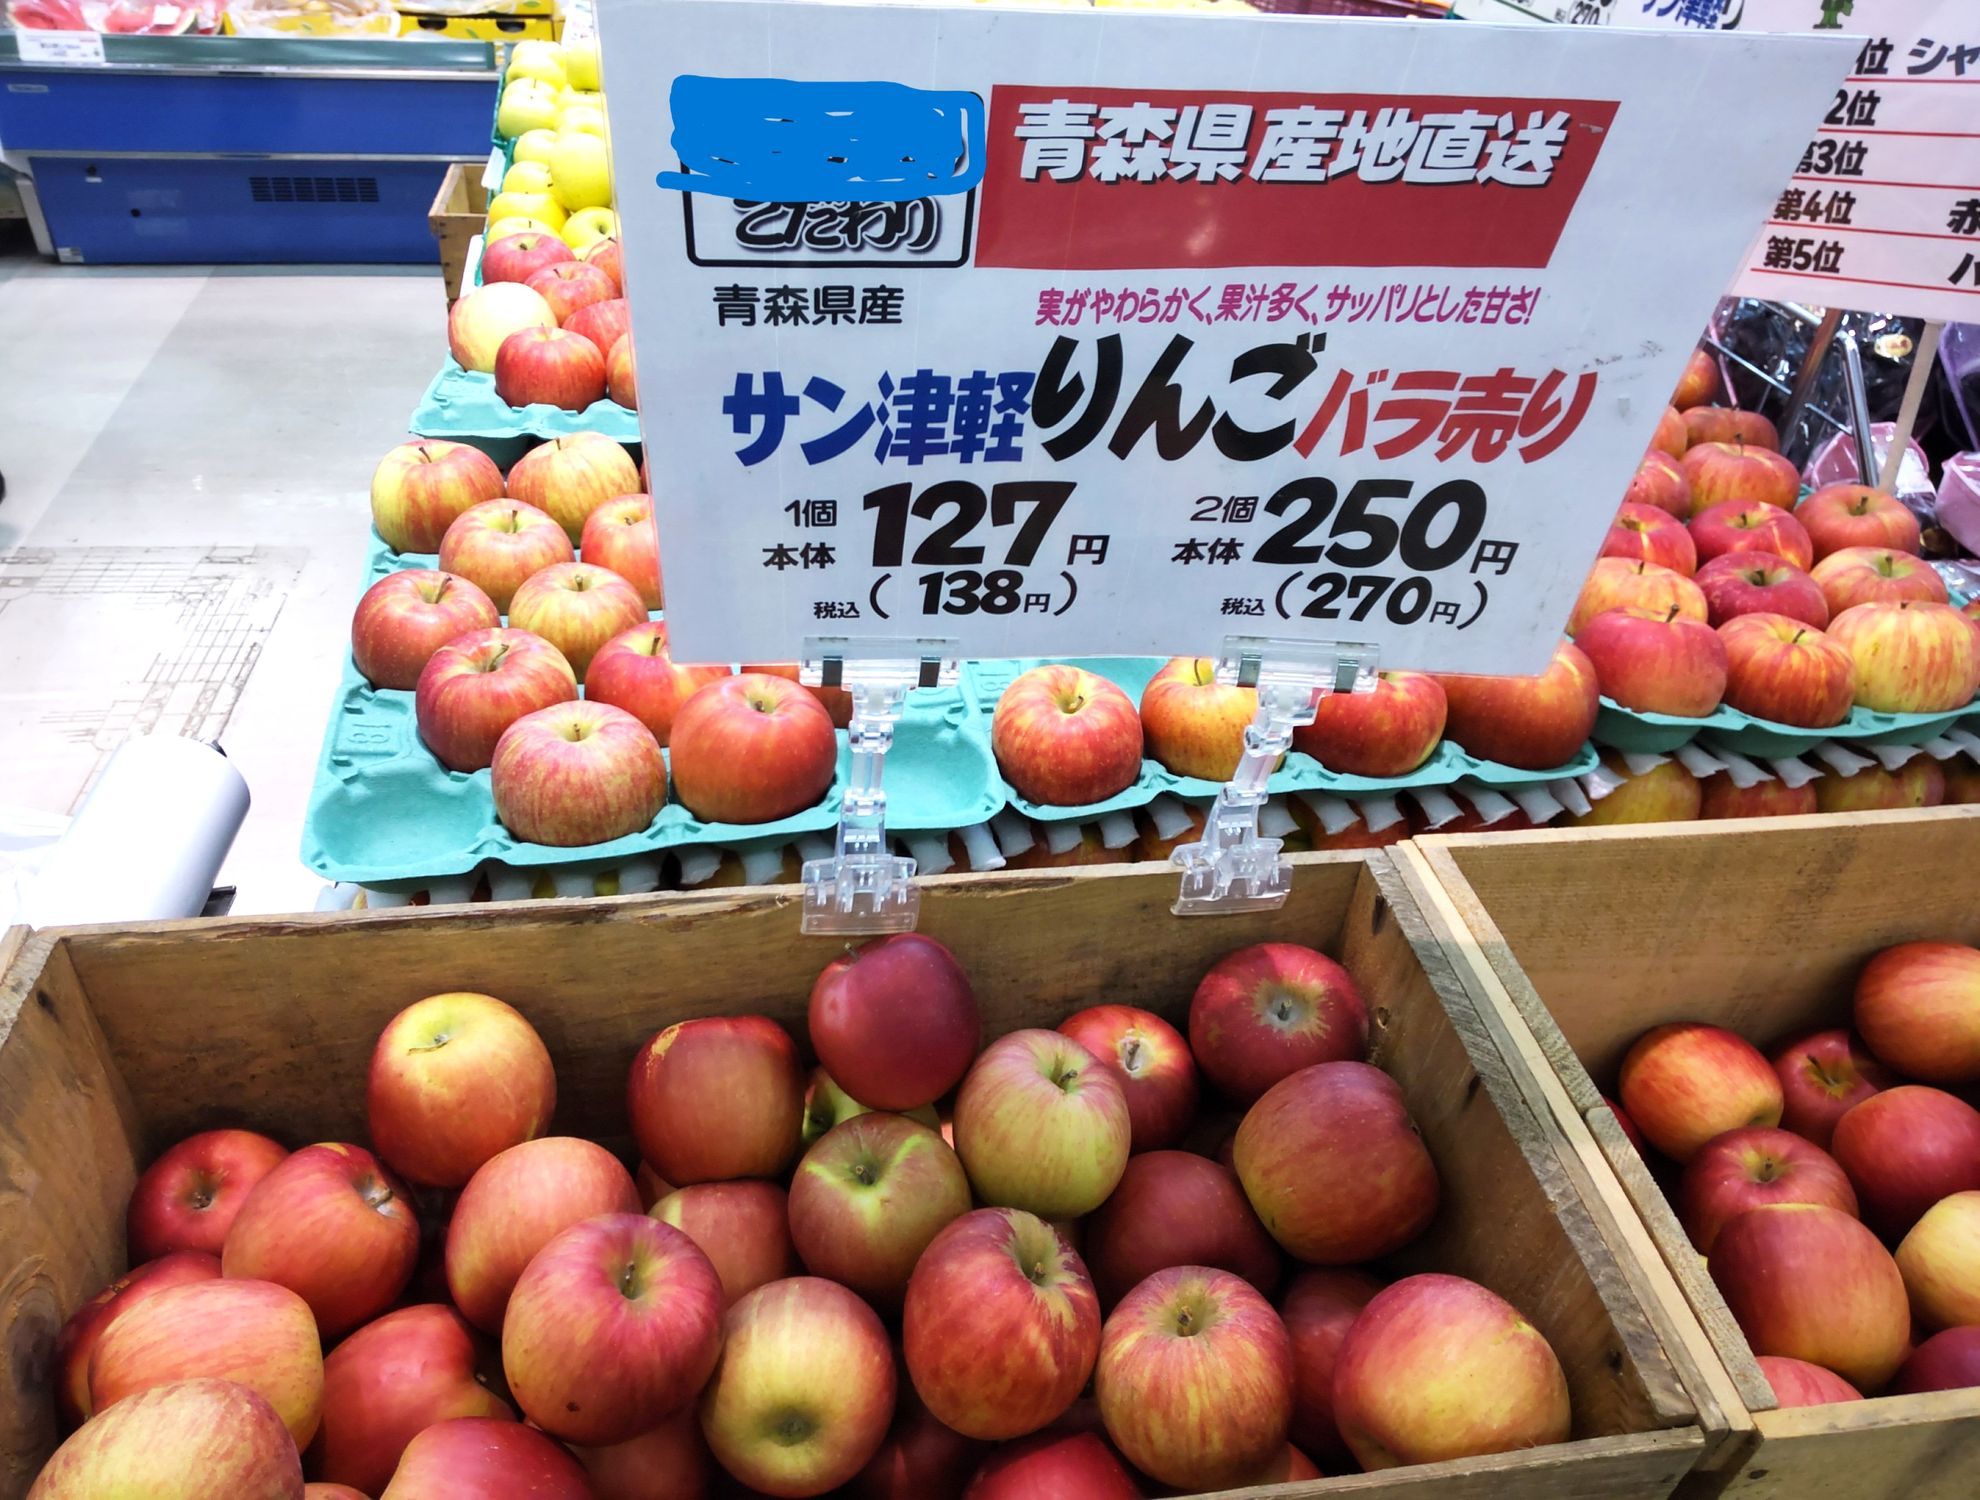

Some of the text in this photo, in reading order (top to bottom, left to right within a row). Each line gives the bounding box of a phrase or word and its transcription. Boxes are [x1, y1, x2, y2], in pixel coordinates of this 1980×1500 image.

[1014, 97, 1571, 187] 青森県産地直送
[1772, 187, 1856, 225] 第4位
[1763, 235, 1844, 273] 第5位
[711, 285, 905, 326] 青森県産
[784, 500, 837, 527] 1個
[1190, 496, 1257, 523] 2個
[762, 543, 836, 570] 本体
[1171, 537, 1244, 565] 本体
[813, 601, 860, 619] 税込
[1220, 597, 1265, 616] 税込
